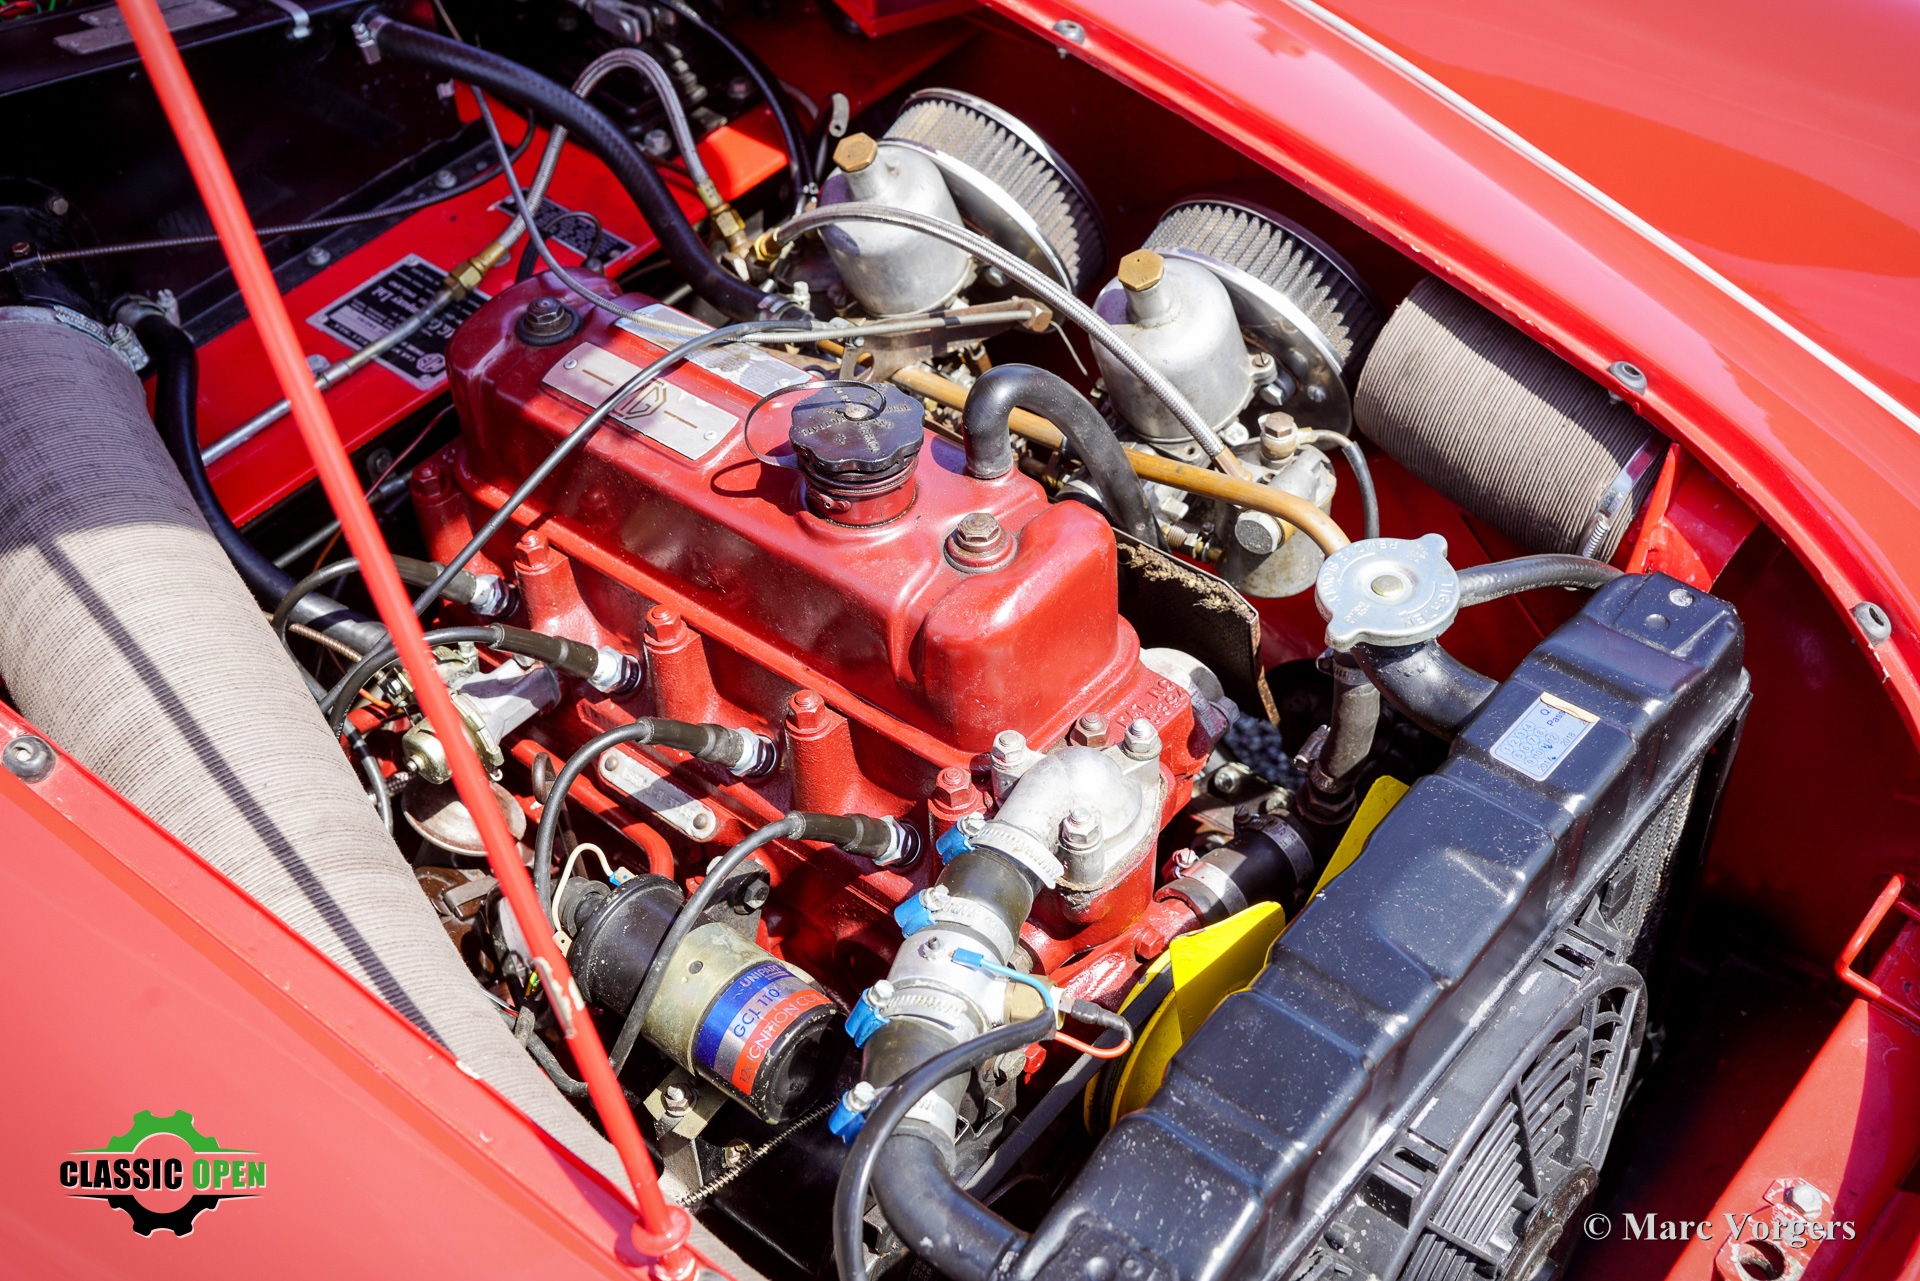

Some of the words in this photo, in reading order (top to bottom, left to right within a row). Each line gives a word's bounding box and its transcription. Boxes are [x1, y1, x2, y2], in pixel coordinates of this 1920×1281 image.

[1335, 539, 1399, 562] REMOVE
[1400, 581, 1454, 627] TIGHTEN
[1559, 731, 1577, 747] 2018
[740, 964, 782, 988] UNIPART
[733, 1008, 762, 1038] GCL
[757, 988, 780, 1006] 110
[746, 1002, 800, 1063] IGNITION
